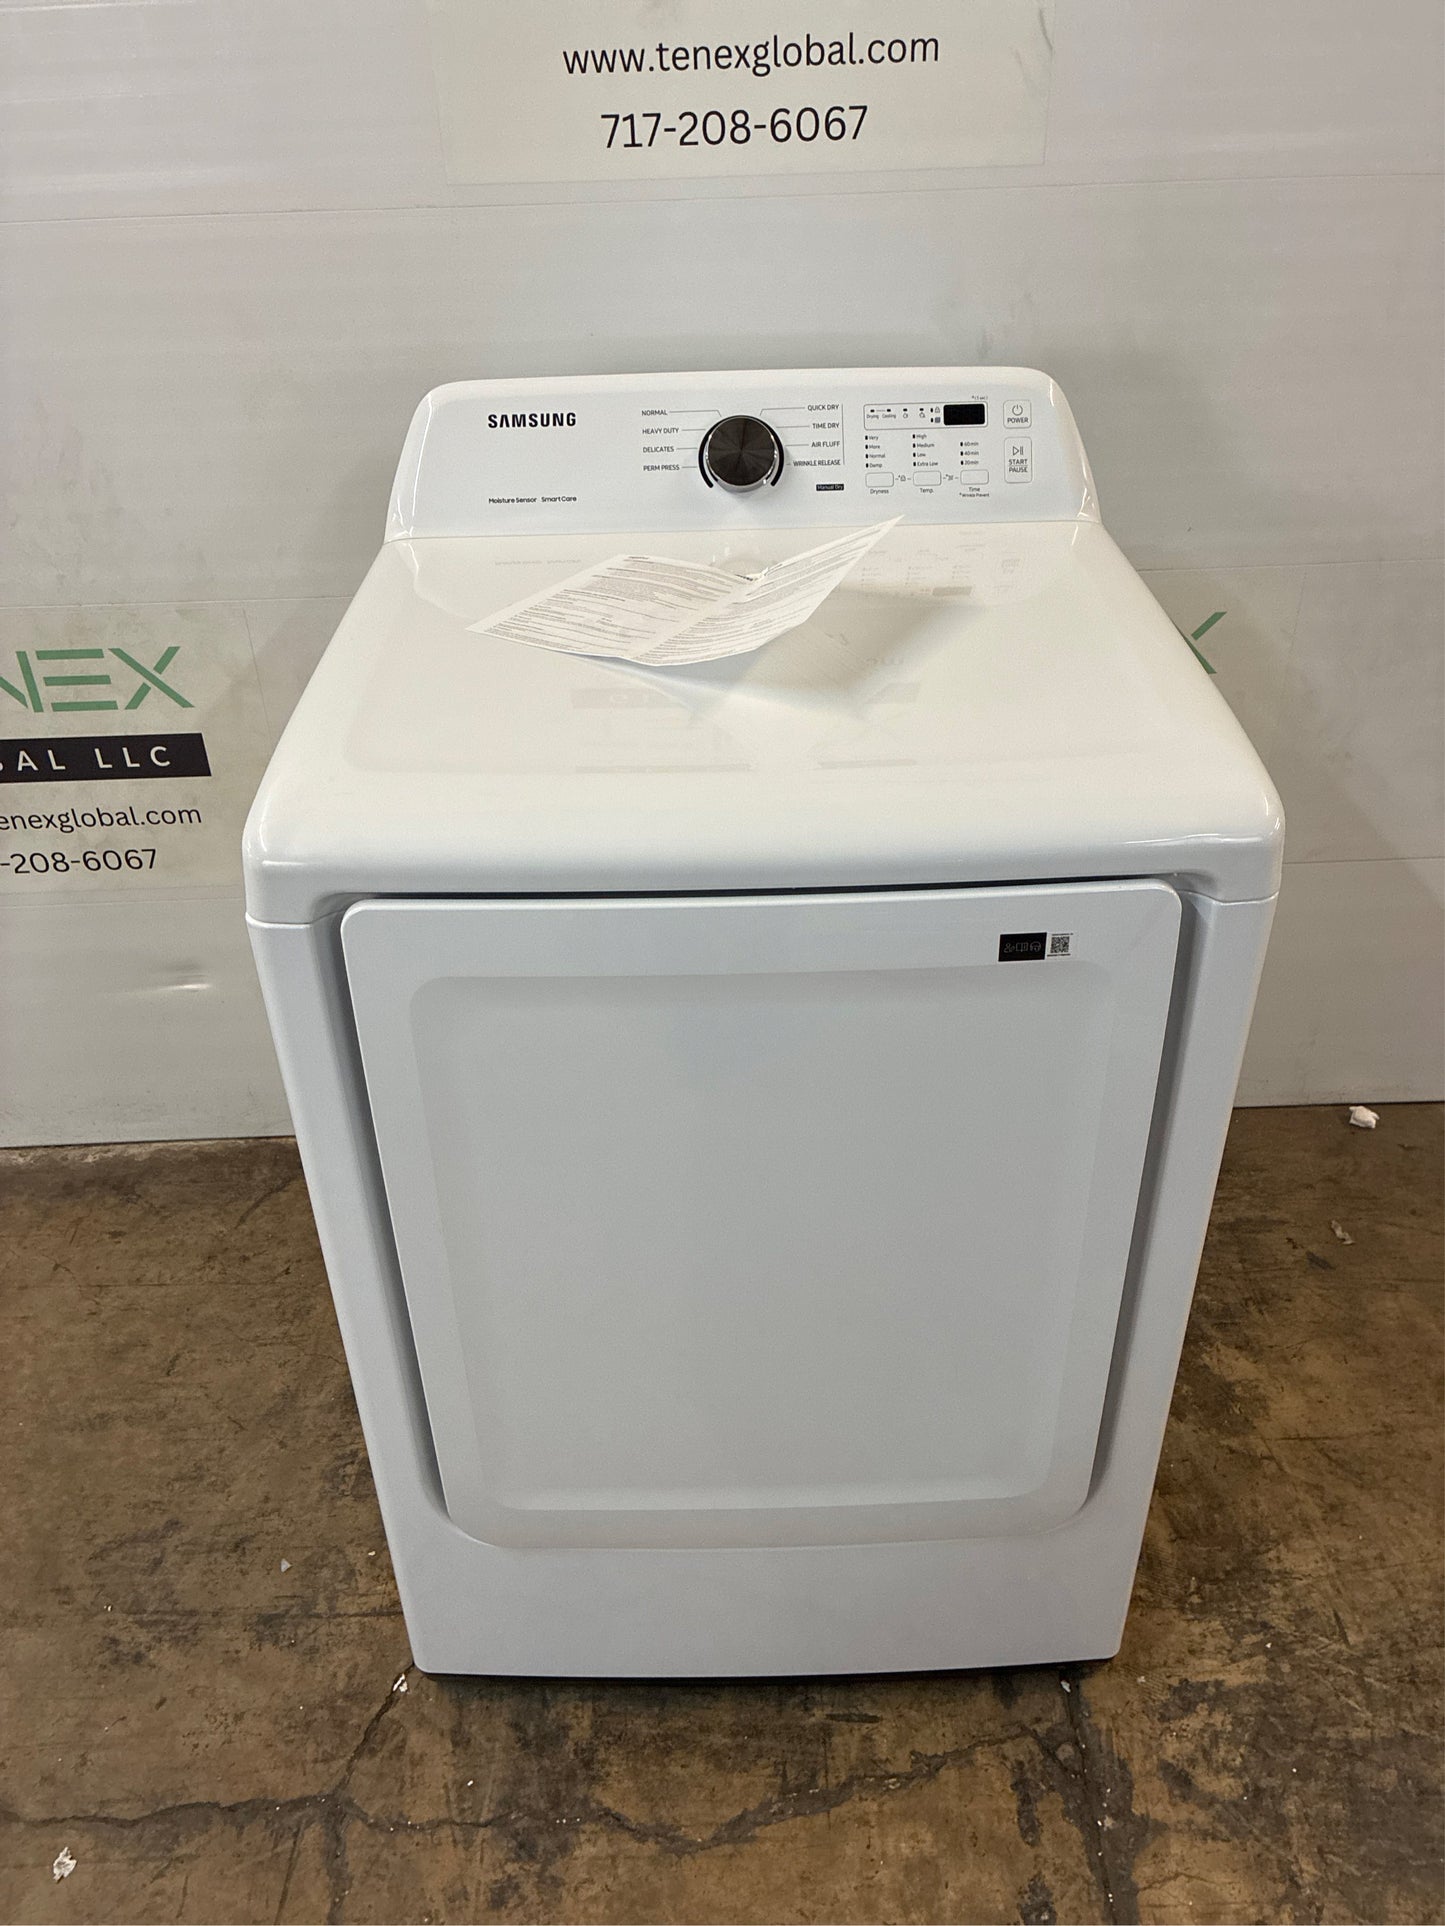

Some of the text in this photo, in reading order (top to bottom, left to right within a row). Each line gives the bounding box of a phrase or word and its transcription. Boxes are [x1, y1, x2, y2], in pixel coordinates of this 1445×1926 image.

[562, 32, 940, 77] www.tenexglobal.com
[600, 105, 869, 149] 717-208-6067
[488, 412, 576, 428] SAMSUNG
[94, 746, 171, 769] LLC
